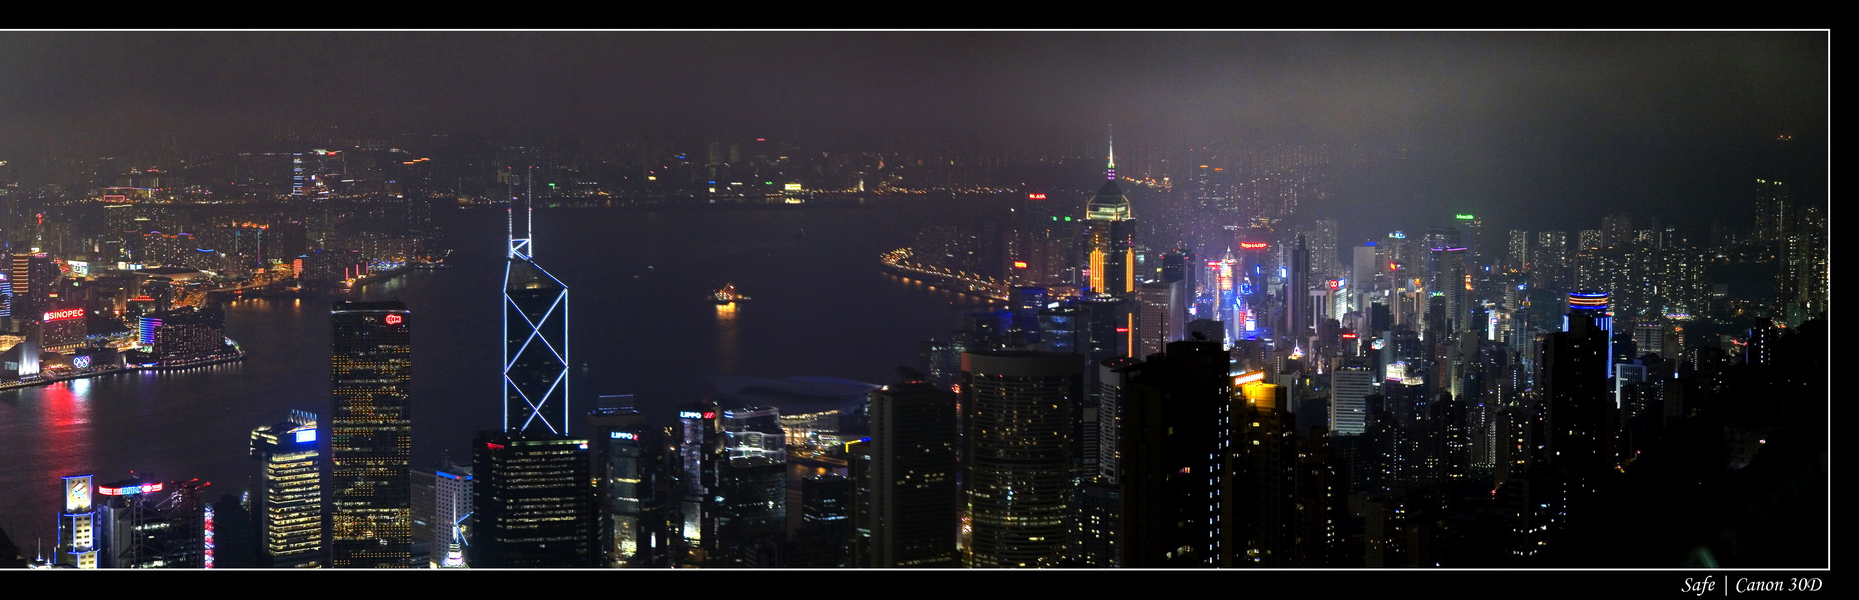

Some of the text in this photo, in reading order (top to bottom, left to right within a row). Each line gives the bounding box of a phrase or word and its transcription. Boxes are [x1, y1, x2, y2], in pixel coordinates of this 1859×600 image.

[1245, 241, 1267, 249] SHARP
[49, 308, 85, 320] SINOPEC
[680, 411, 702, 419] LIPPO
[611, 431, 634, 439] LIPPO
